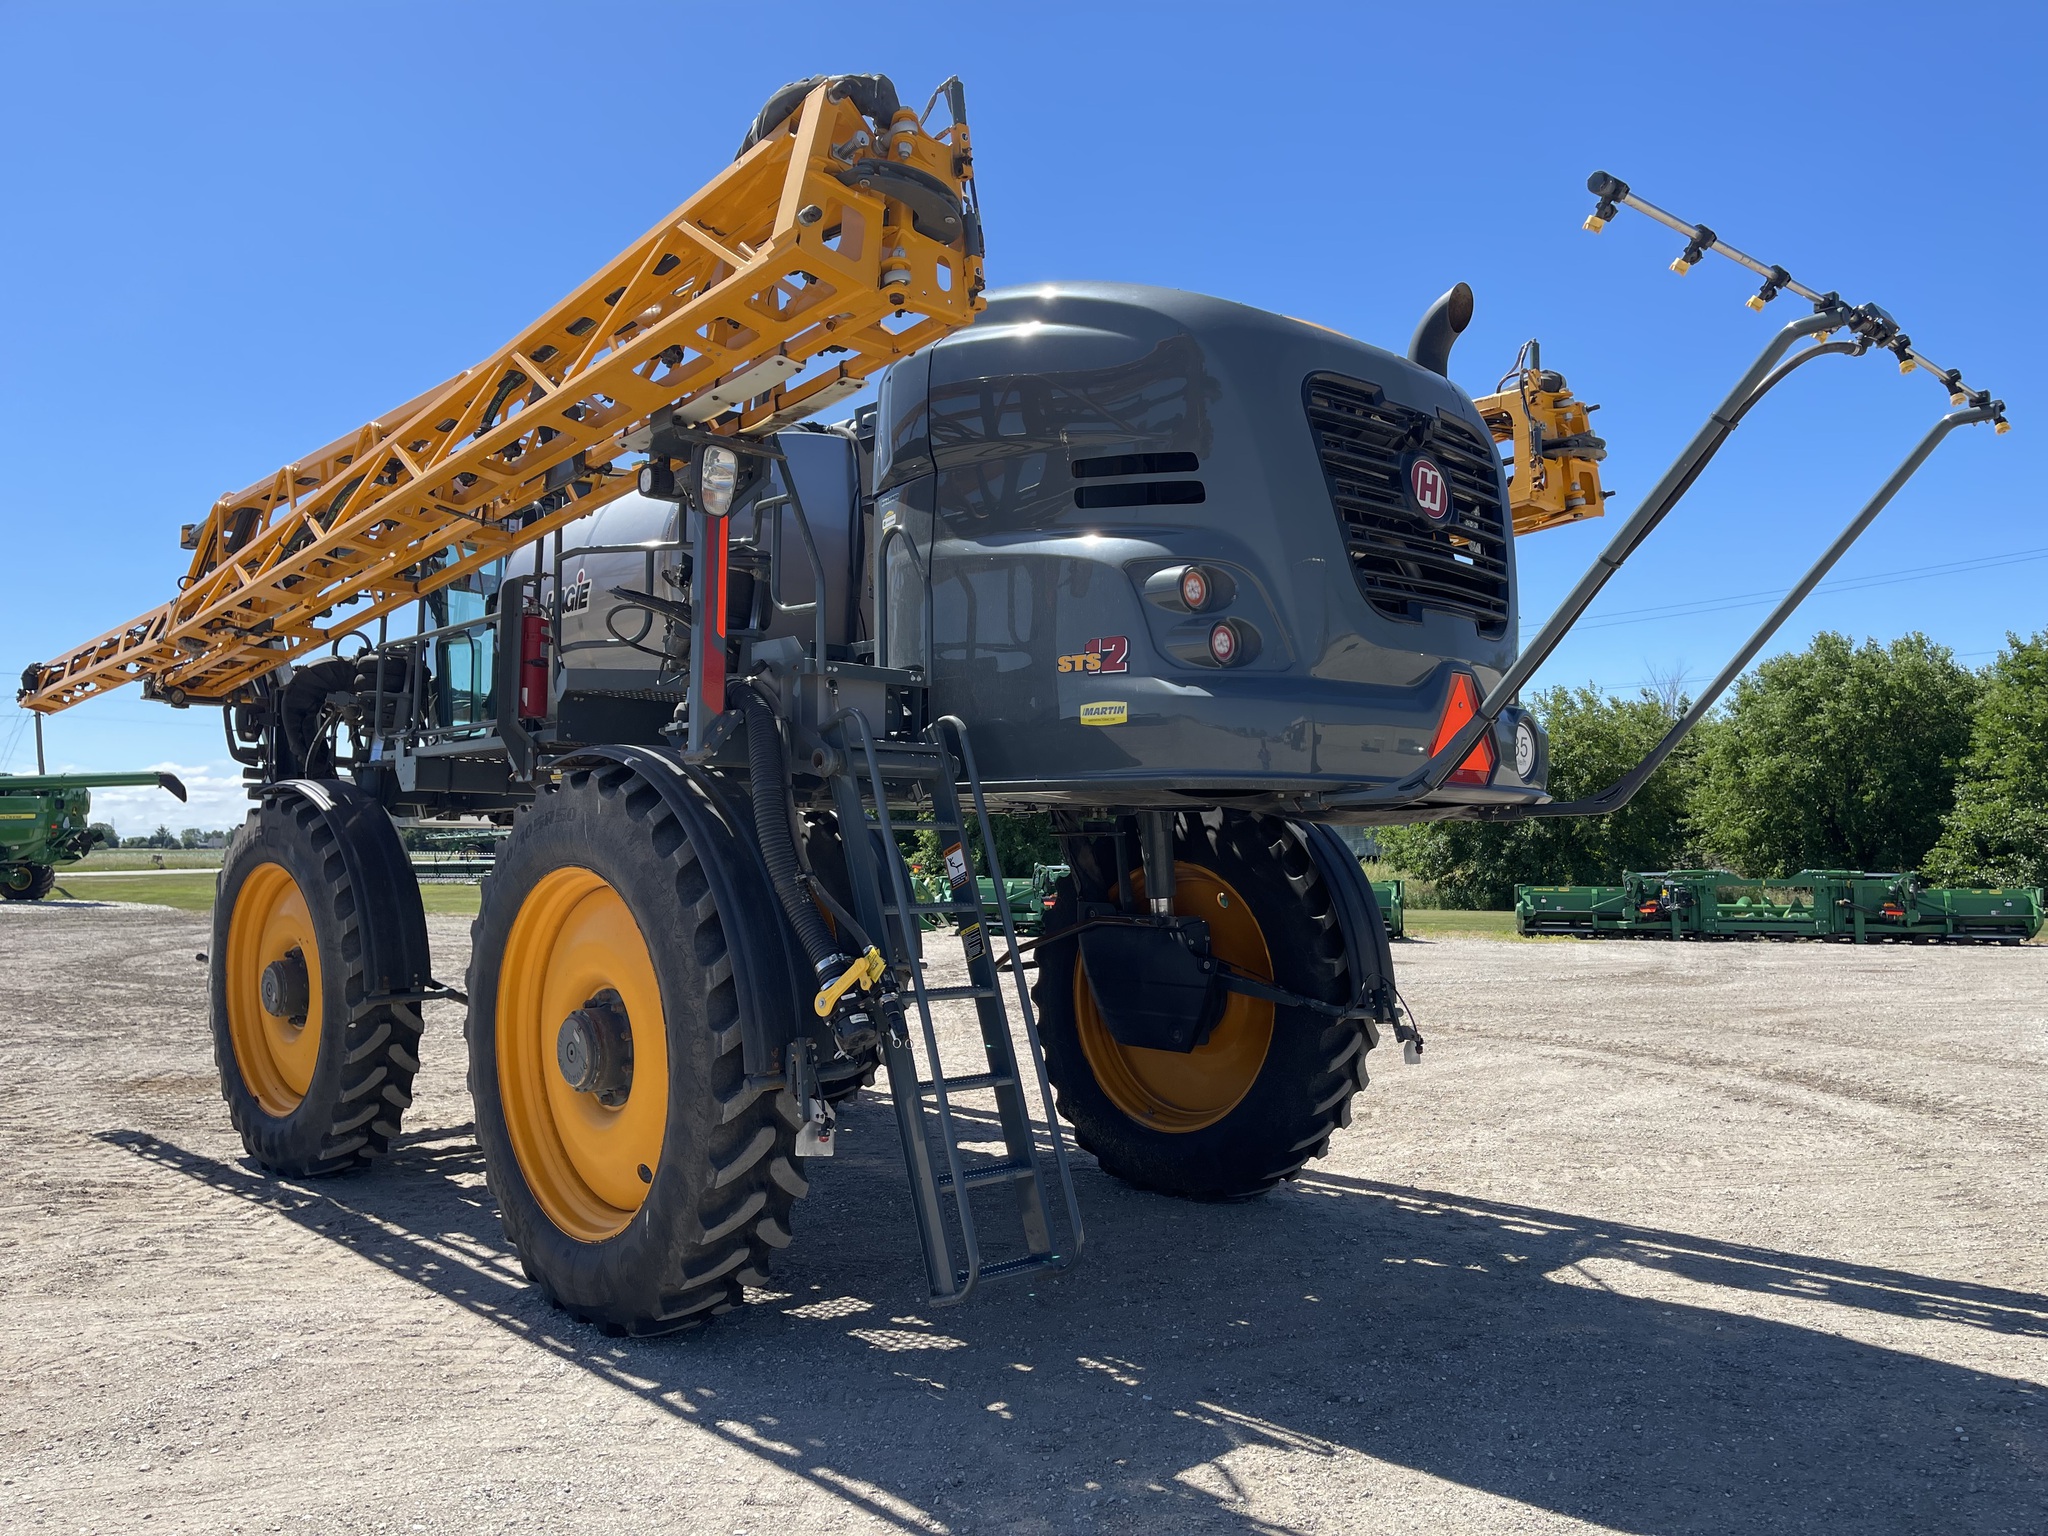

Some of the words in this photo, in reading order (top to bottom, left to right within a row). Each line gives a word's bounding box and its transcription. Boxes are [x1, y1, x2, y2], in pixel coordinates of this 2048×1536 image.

[1416, 467, 1442, 511] H
[1057, 652, 1101, 673] STS
[1084, 636, 1128, 674] 12
[1083, 705, 1125, 716] MARTIN
